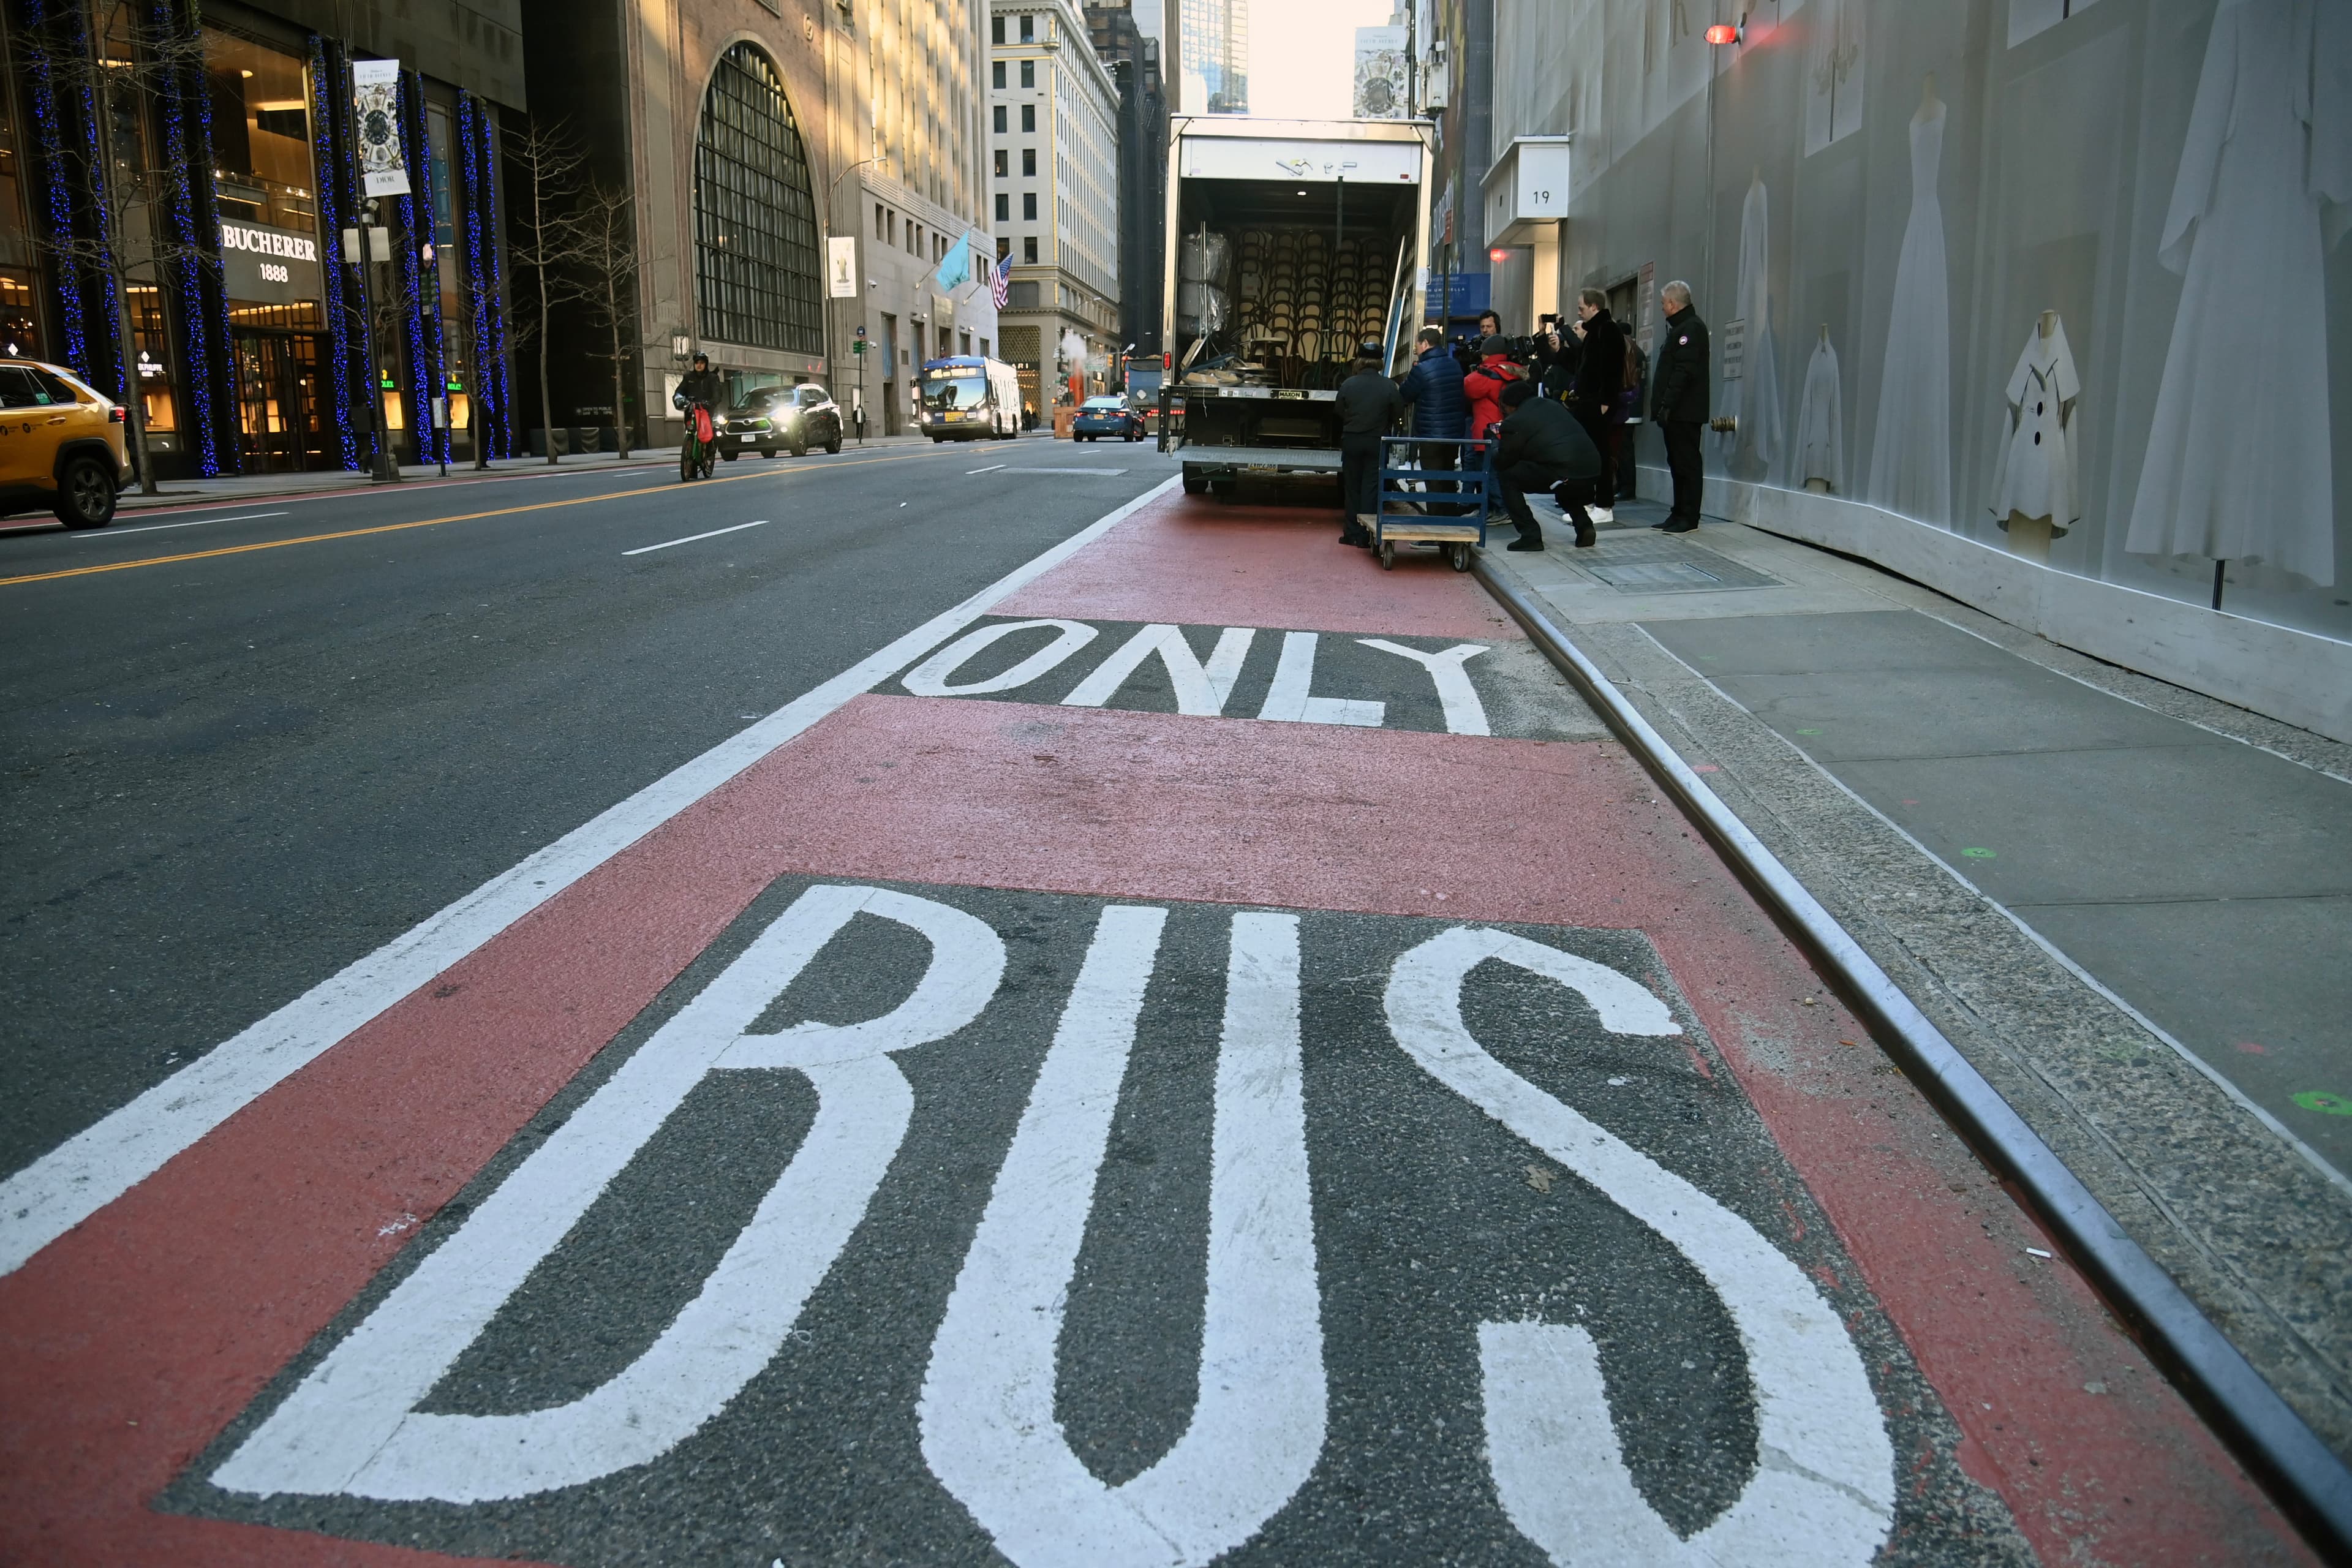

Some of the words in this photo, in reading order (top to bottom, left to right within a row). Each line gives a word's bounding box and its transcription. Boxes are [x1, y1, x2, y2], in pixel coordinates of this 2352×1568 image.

[1533, 190, 1550, 204] 19
[222, 225, 317, 262] BUCHERER
[260, 263, 288, 283] 1888
[902, 619, 1491, 736] ONLY
[212, 885, 1896, 1568] BUS
